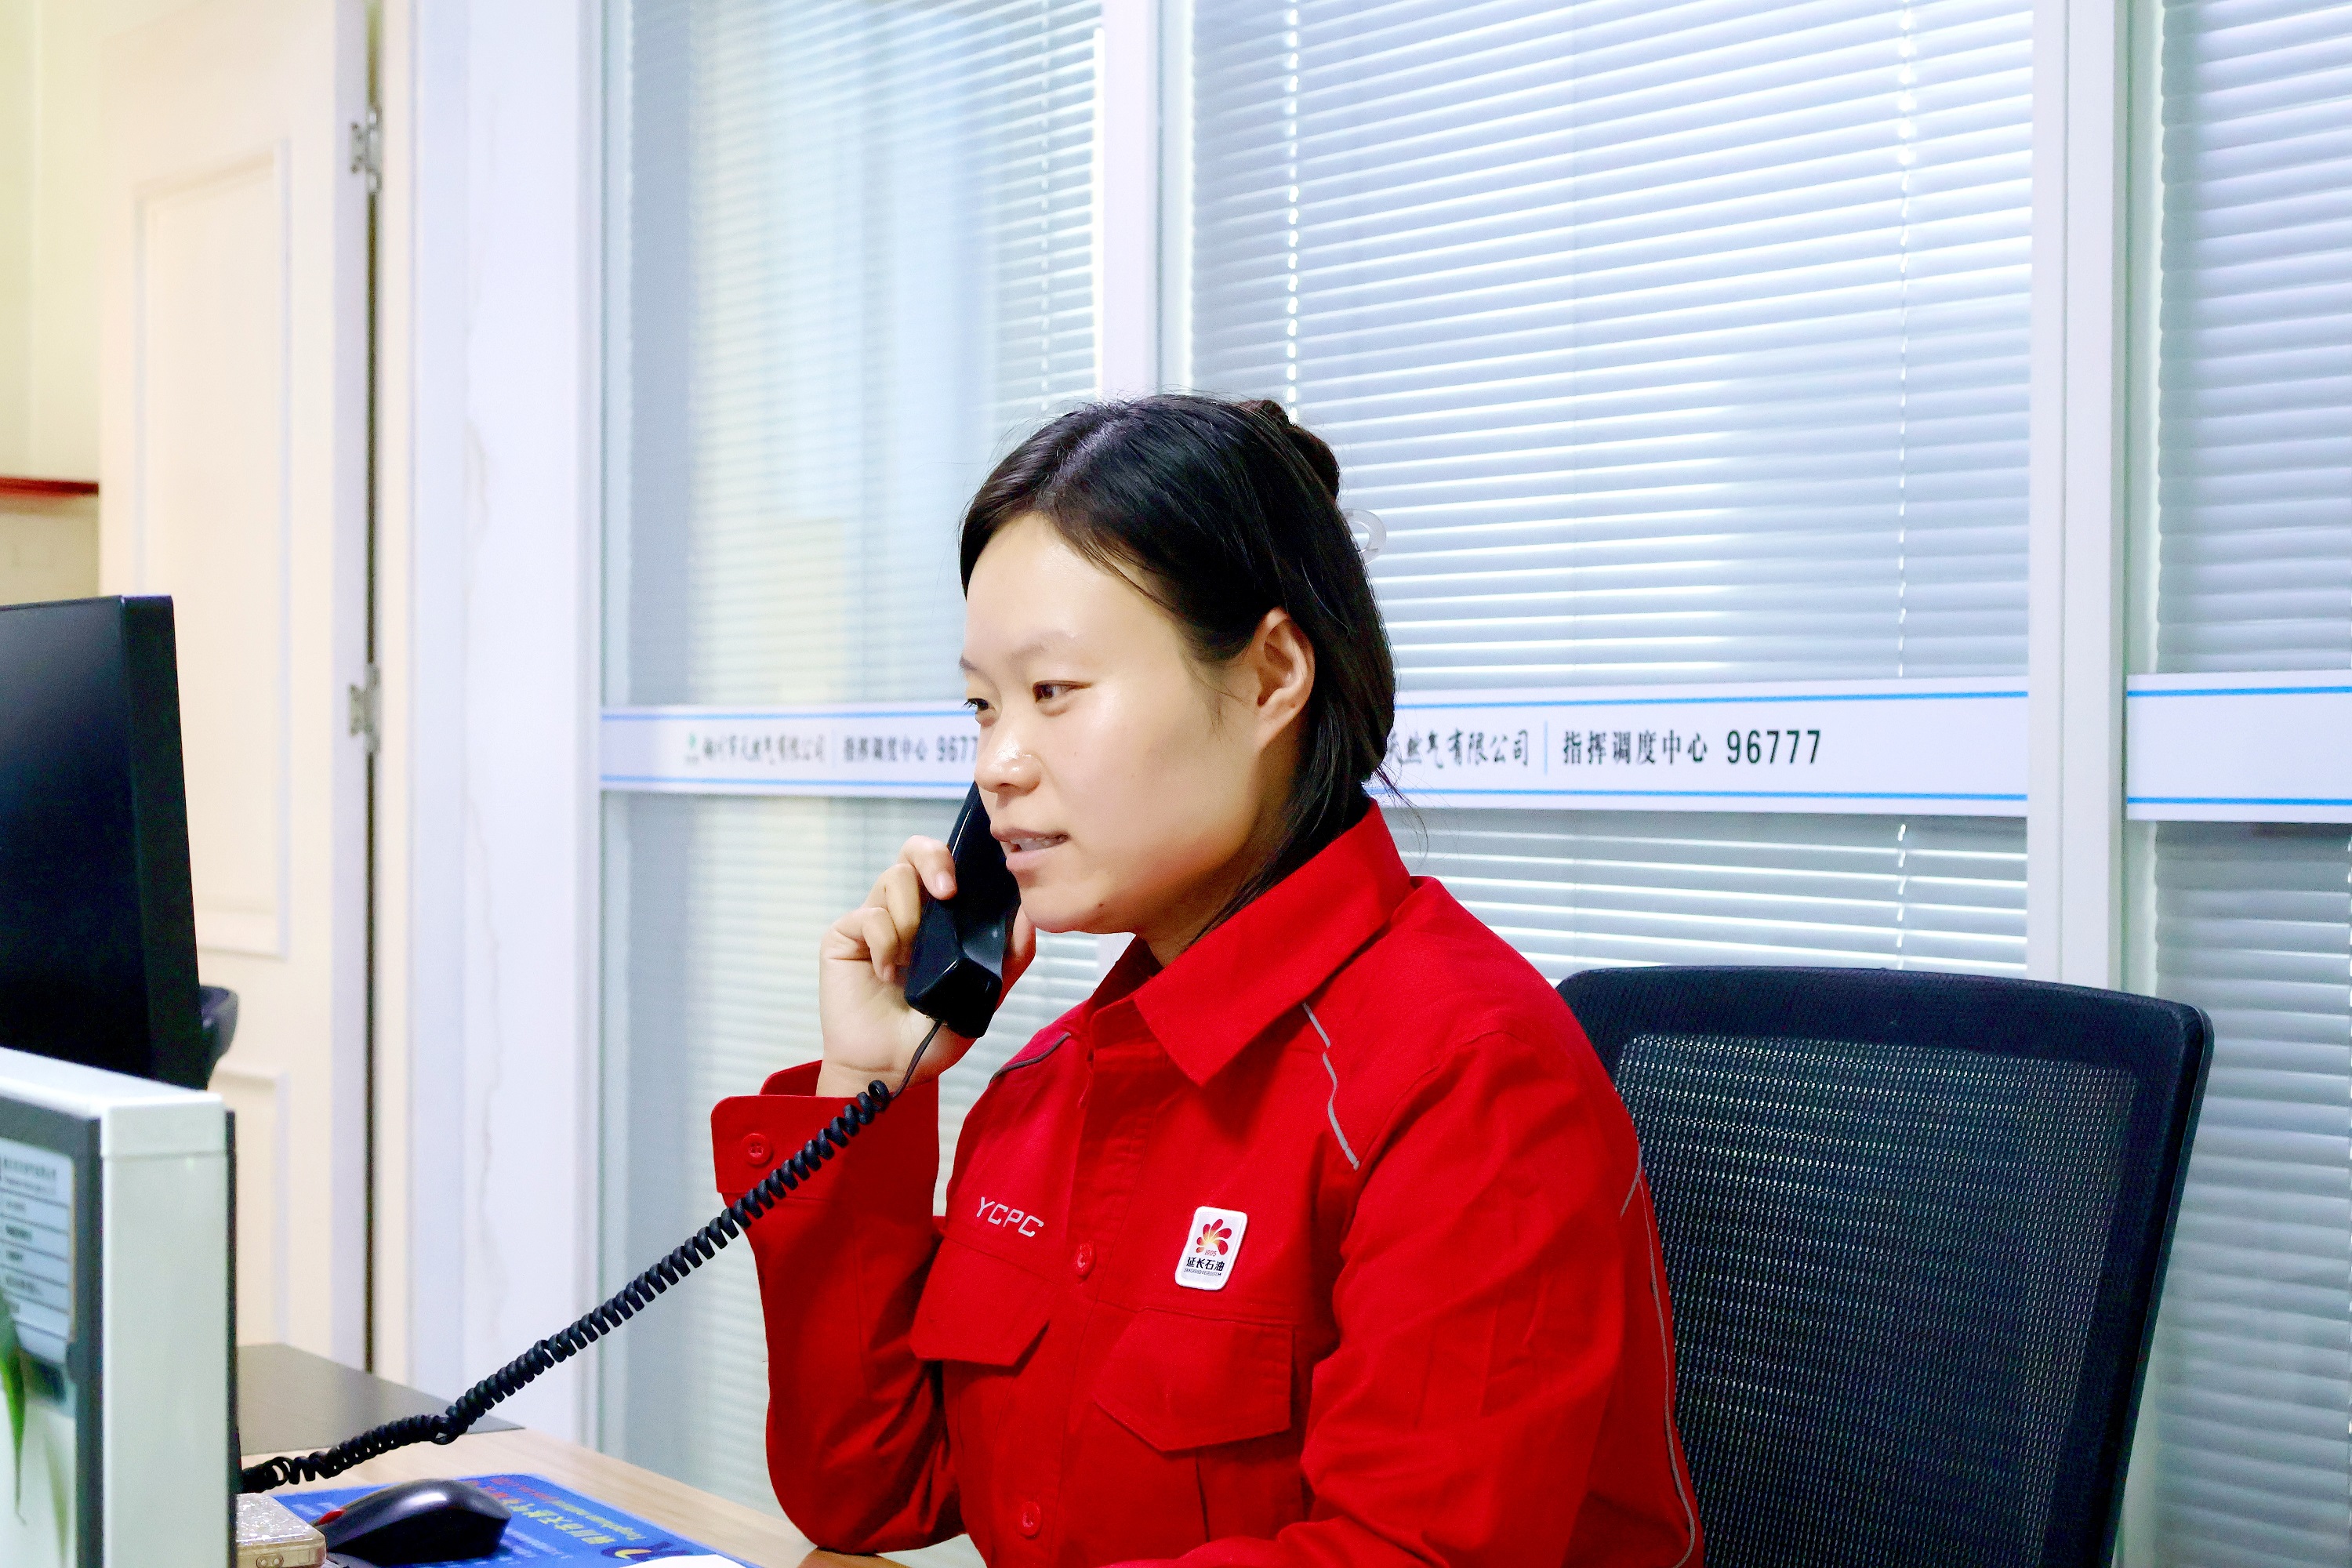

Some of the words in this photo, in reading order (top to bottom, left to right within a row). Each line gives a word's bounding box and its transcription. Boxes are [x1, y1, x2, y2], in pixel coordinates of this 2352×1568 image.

[1563, 728, 1708, 765] 指挥调度中心
[1726, 729, 1821, 764] 96777
[976, 1196, 1044, 1238] YCPC
[1186, 1257, 1225, 1271] 延长石油
